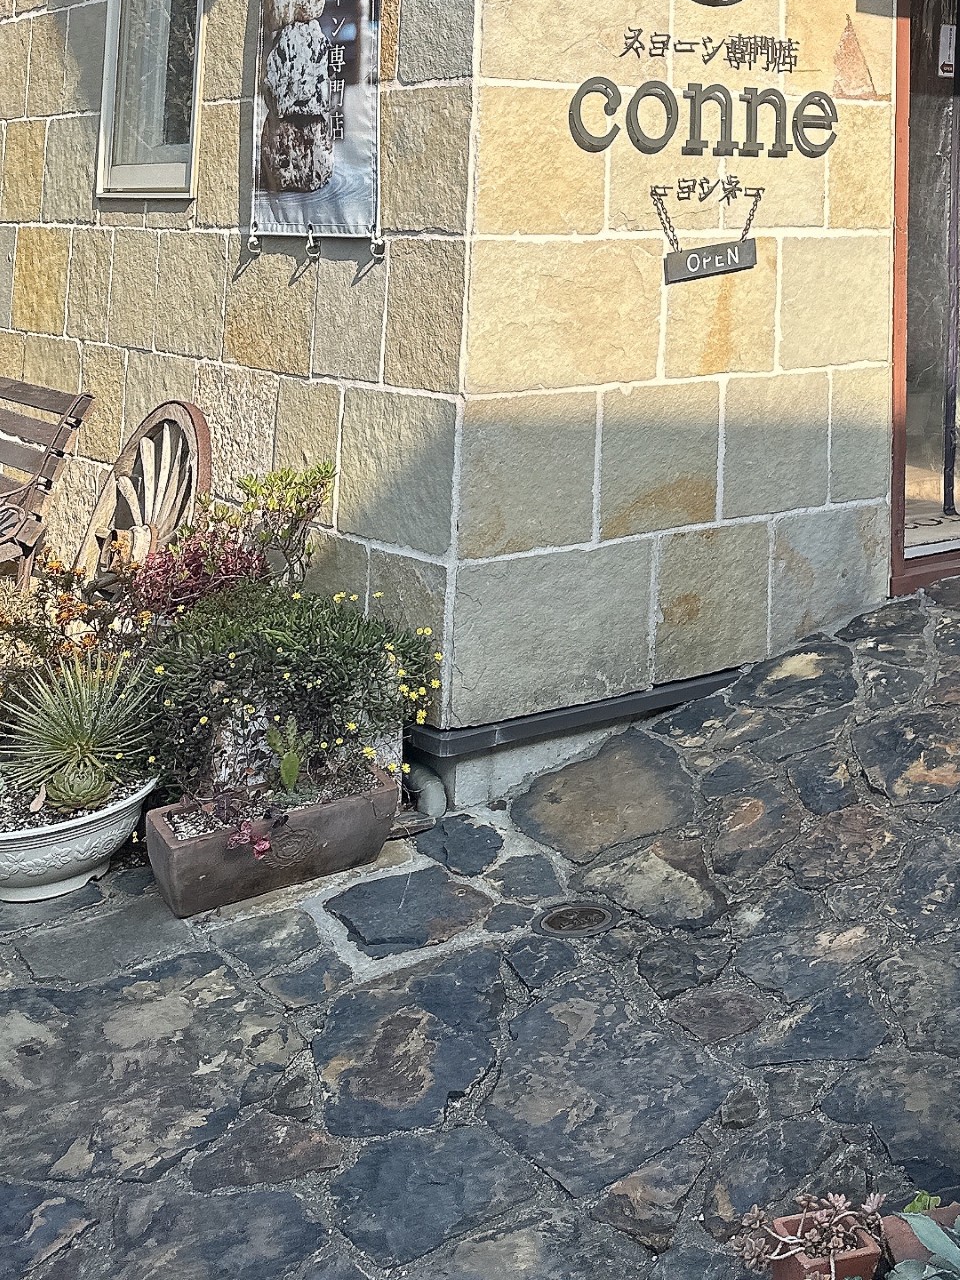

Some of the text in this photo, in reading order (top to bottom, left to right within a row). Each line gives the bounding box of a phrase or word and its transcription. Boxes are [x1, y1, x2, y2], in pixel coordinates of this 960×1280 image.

[618, 25, 800, 74] スコーン専門店
[568, 76, 838, 158] conne
[686, 246, 740, 273] OPEN
